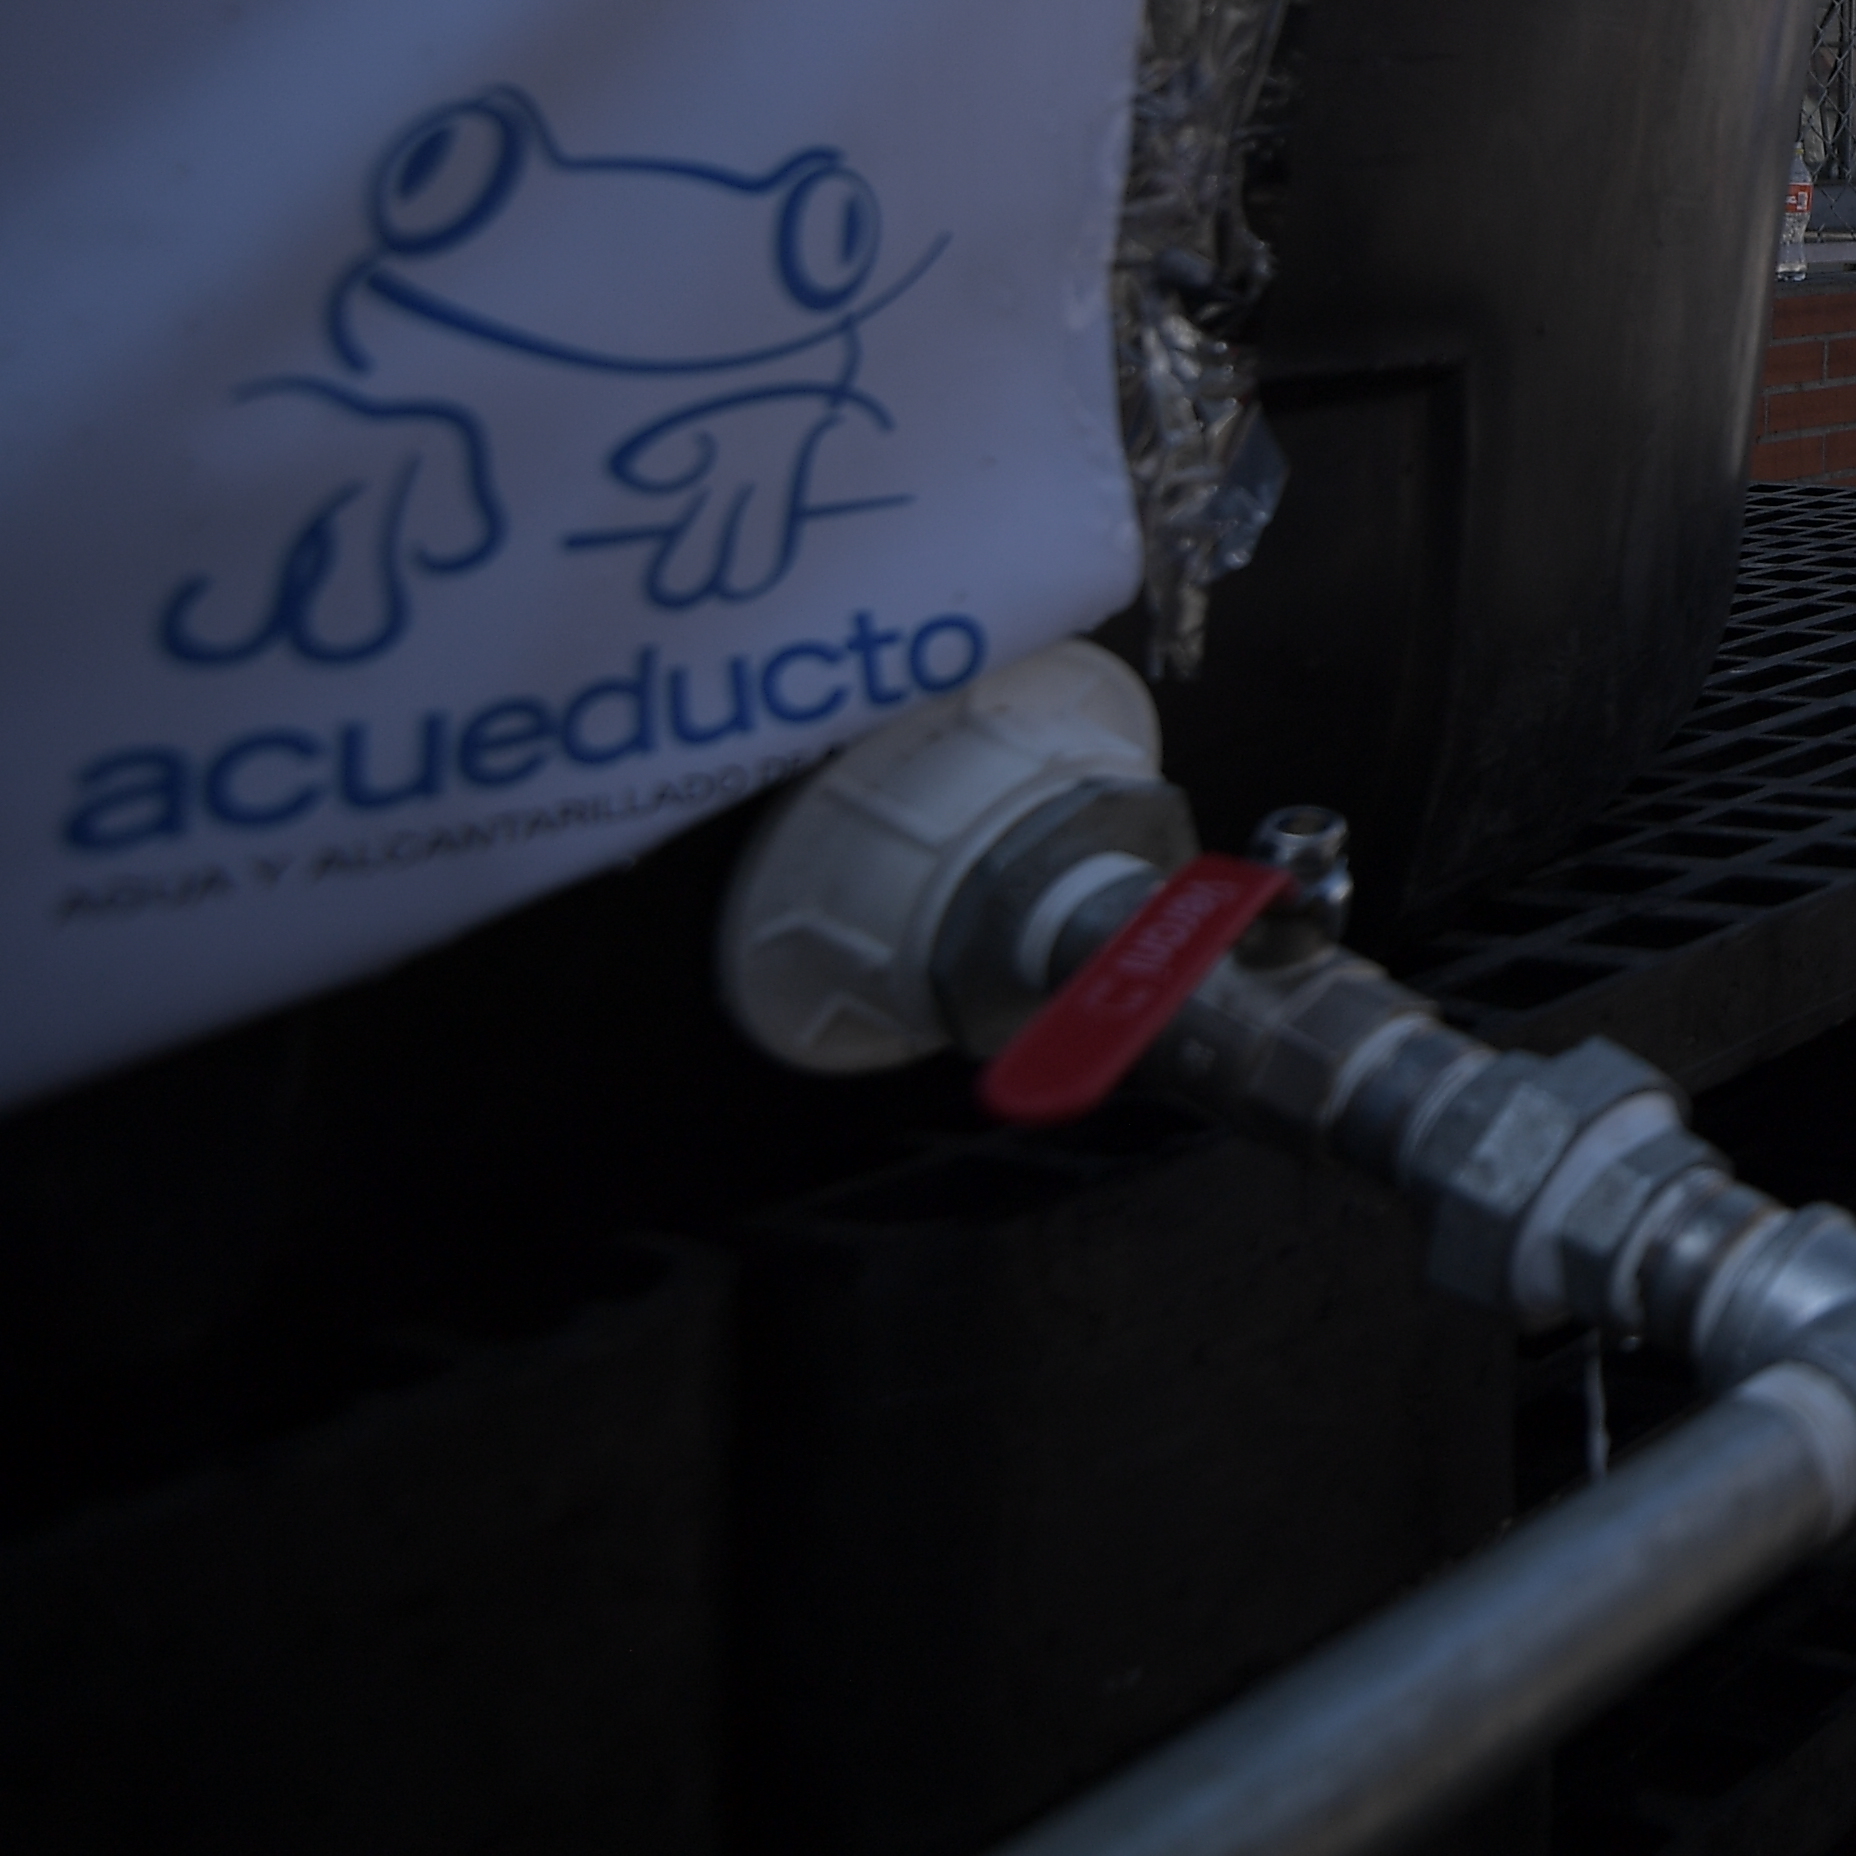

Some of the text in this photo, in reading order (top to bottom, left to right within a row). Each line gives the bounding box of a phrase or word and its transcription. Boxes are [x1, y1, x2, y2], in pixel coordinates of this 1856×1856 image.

[61, 606, 989, 858] acueducto
[54, 866, 237, 926] AGUA
[252, 854, 292, 889] Y
[309, 760, 750, 883] ALCANTARILLADO
